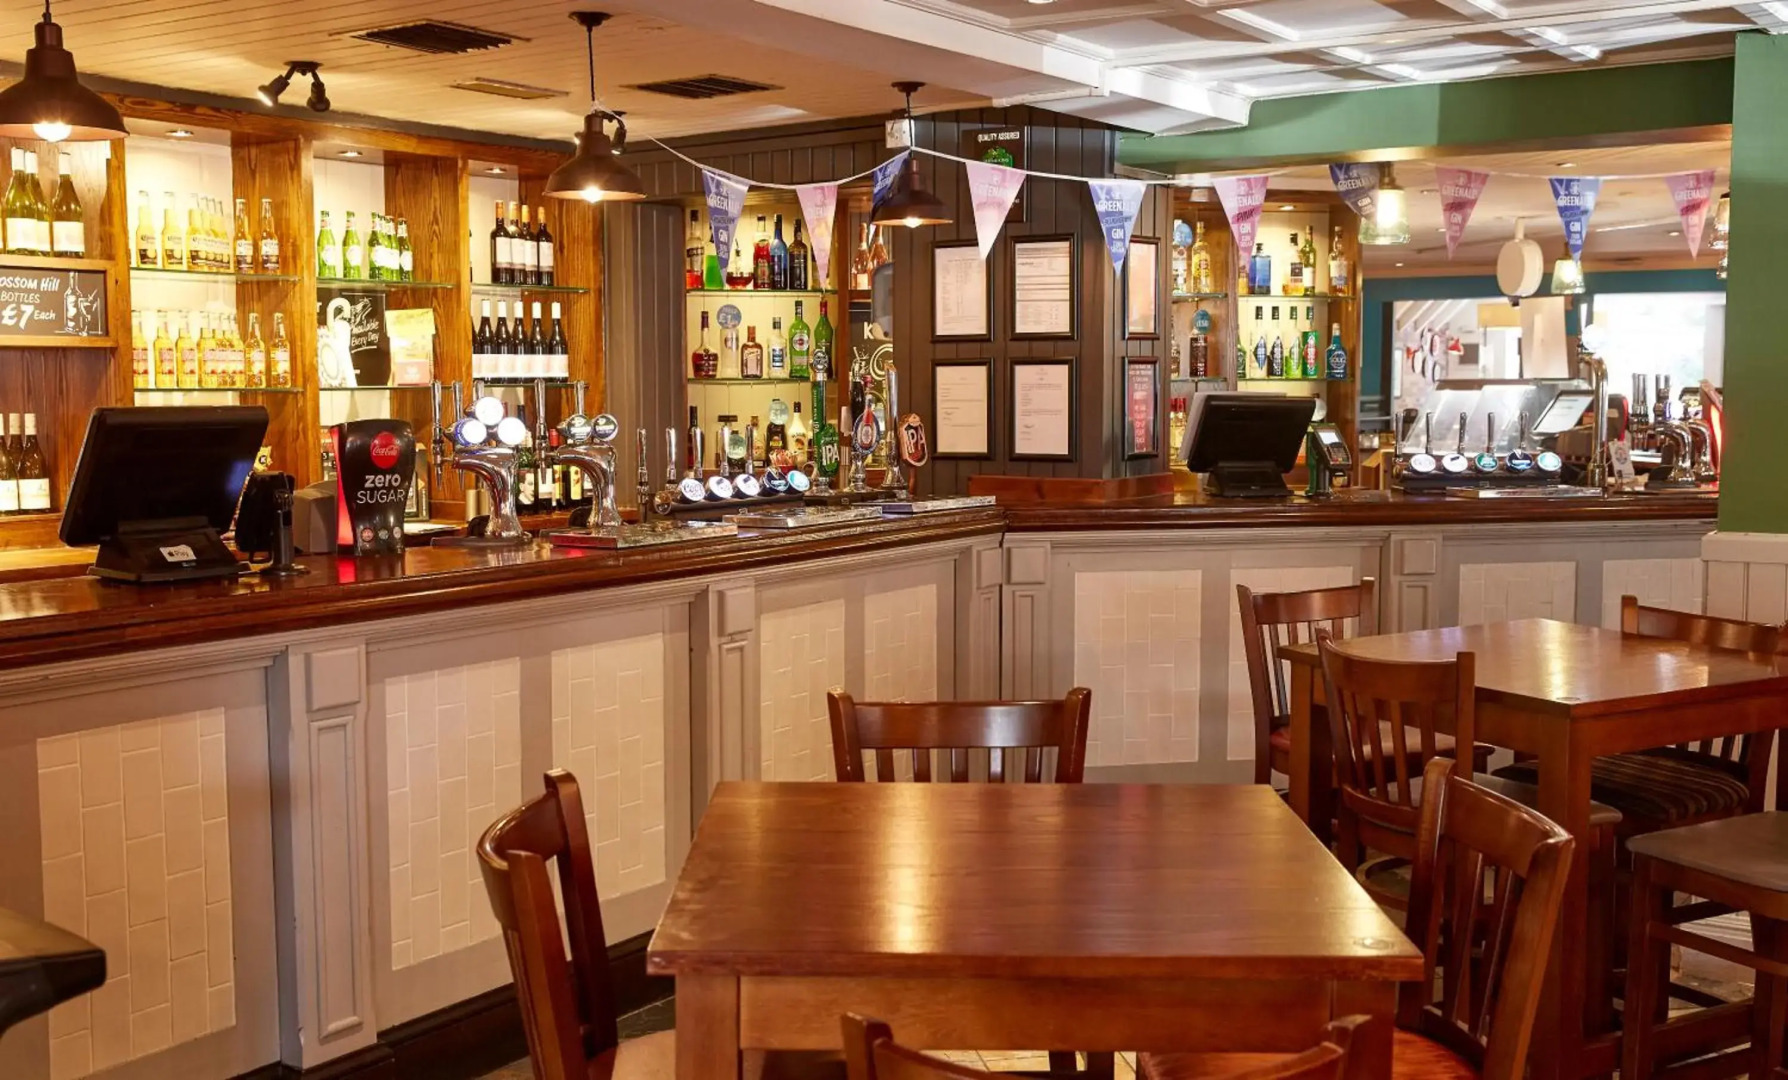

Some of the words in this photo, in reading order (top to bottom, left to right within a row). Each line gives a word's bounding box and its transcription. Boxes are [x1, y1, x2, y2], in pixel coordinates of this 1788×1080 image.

[977, 133, 998, 144] QUALITY
[998, 131, 1020, 140] ASSURED
[1111, 228, 1124, 239] GIN
[40, 276, 60, 291] Hill
[0, 291, 41, 304] BOTTLES
[1, 303, 35, 330] £7
[34, 309, 56, 320] Each
[351, 337, 368, 348] Every
[368, 332, 380, 344] Day
[905, 425, 926, 454] IPA
[821, 442, 840, 466] IPA
[364, 474, 402, 488] zero
[356, 489, 405, 504] SUGAR
